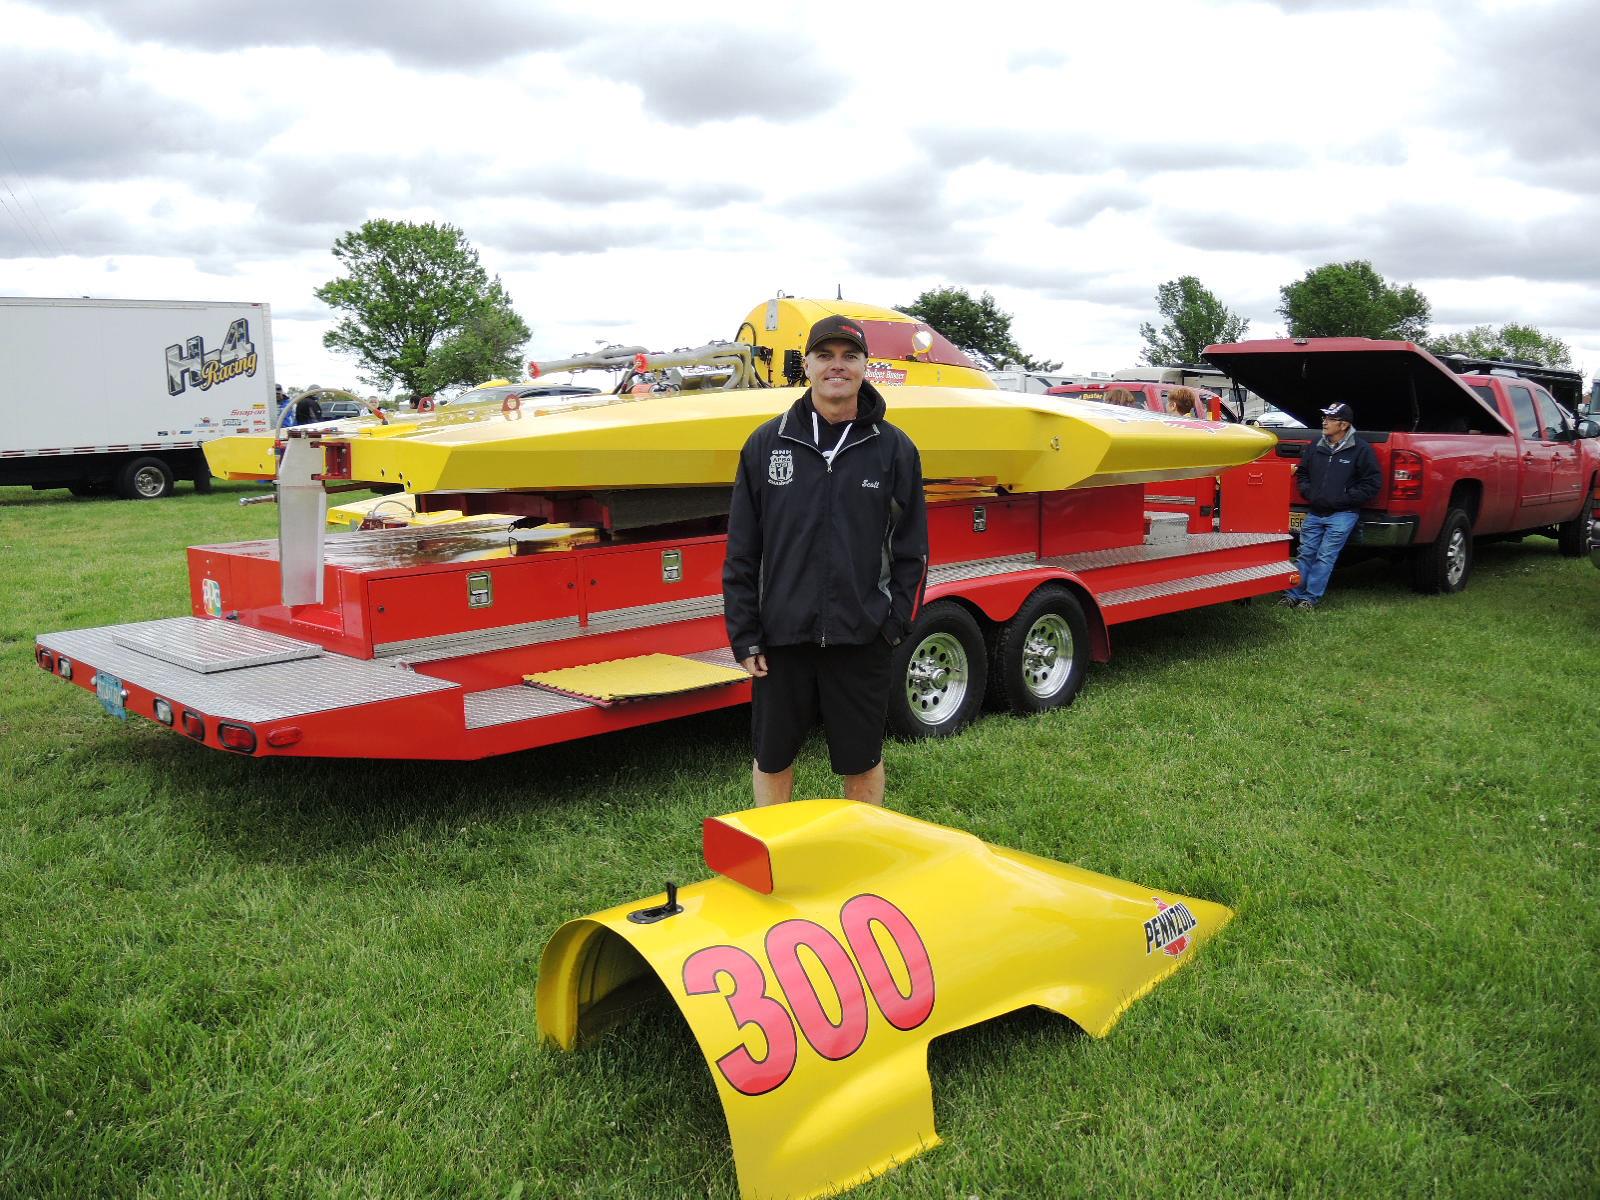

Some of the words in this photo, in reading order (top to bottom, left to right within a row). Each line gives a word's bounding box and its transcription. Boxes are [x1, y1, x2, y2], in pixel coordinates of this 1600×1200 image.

[200, 352, 257, 391] Racing
[862, 479, 880, 488] Scott
[1143, 902, 1197, 954] PENNZOIL
[682, 893, 935, 1096] 300
